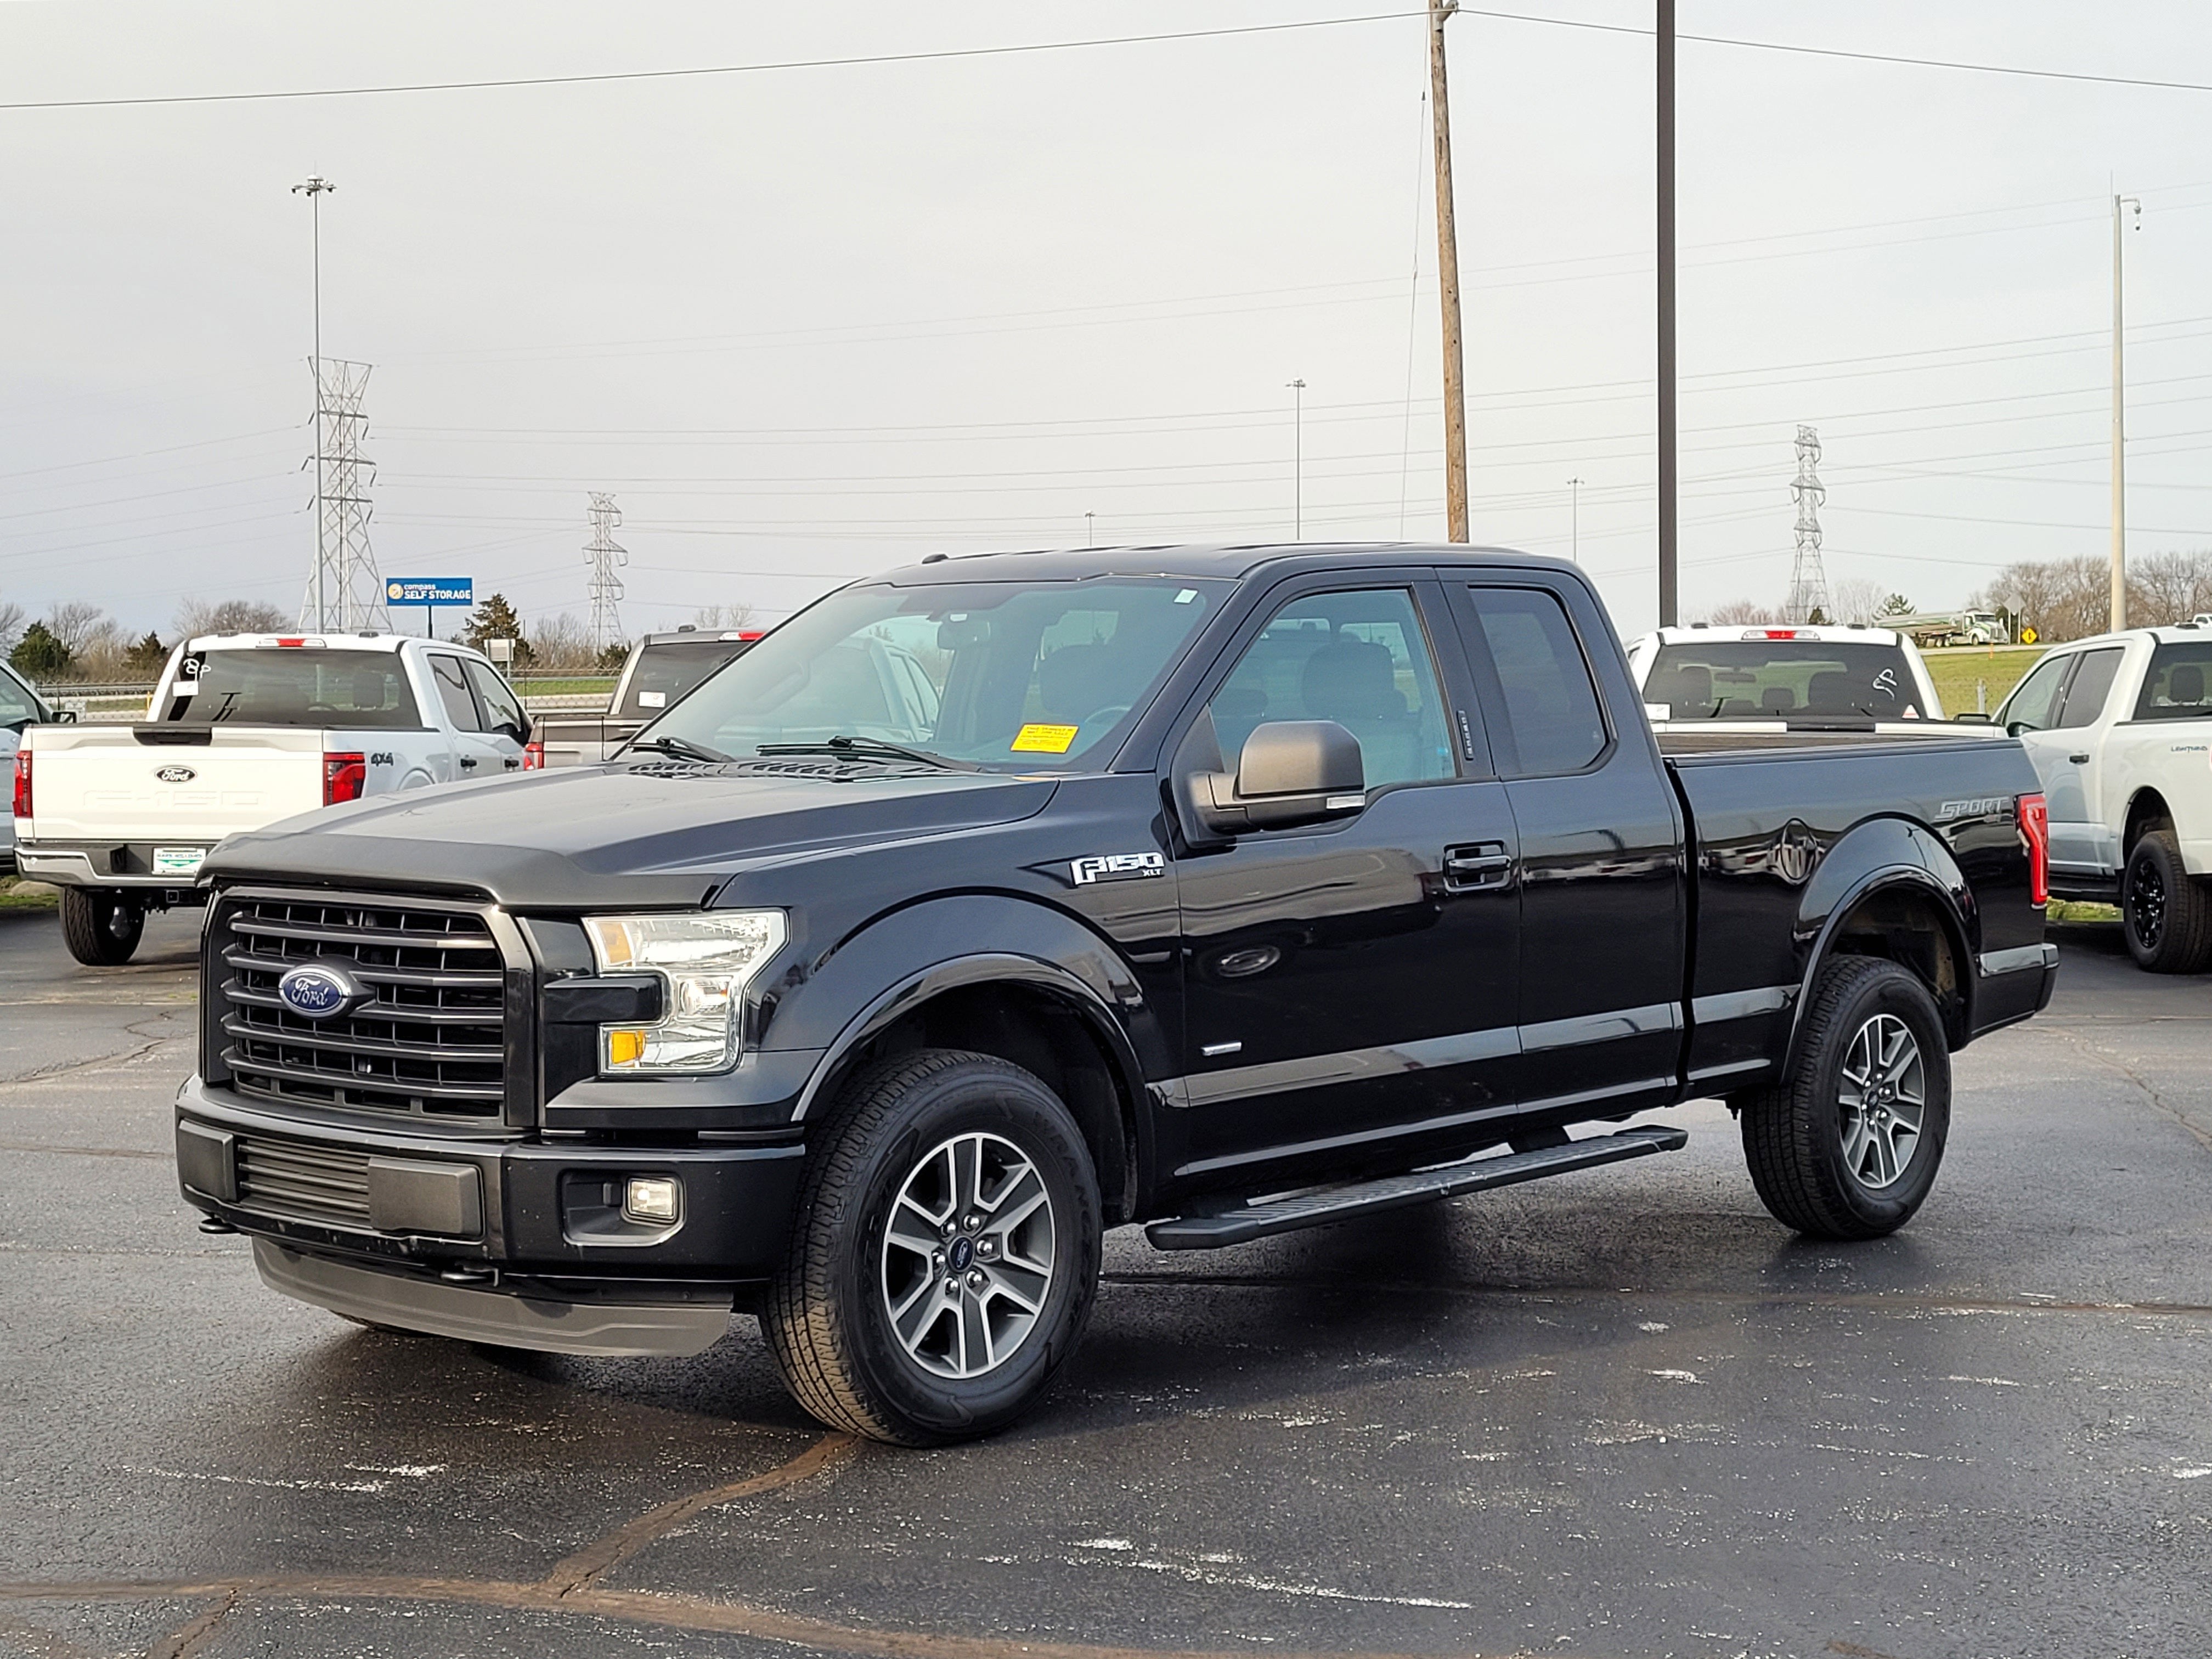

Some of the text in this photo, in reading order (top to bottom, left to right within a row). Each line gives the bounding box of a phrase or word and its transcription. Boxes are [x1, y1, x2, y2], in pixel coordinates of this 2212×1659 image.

[404, 590, 471, 599] SELF STORAGE
[162, 768, 191, 781] Ford
[1933, 797, 2010, 822] SPORT
[1142, 868, 1163, 877] XLT
[291, 978, 329, 1006] Ford
